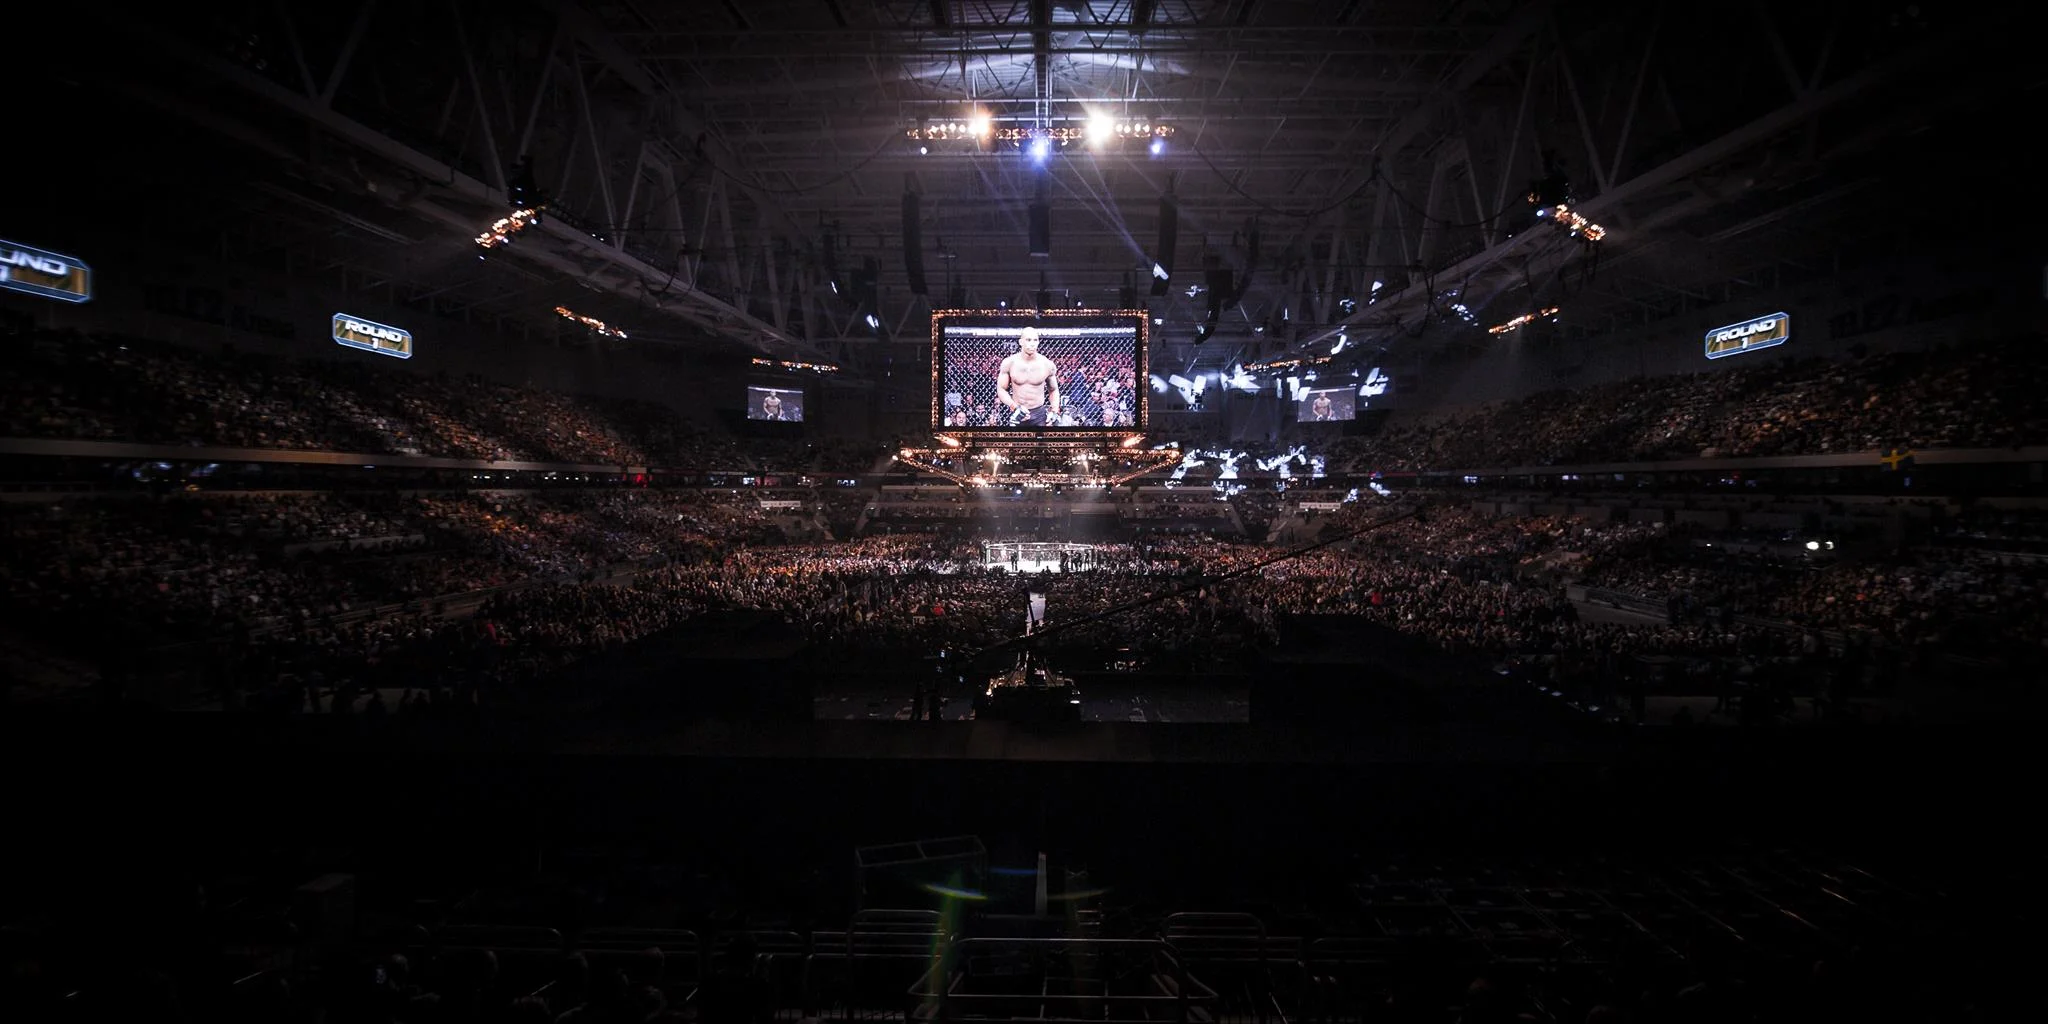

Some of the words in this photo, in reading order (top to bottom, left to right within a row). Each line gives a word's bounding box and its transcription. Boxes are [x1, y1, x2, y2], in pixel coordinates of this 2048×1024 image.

[345, 320, 403, 342] ROUND
[1715, 319, 1777, 343] ROUND
[371, 338, 379, 350] 1
[1741, 337, 1749, 349] 1
